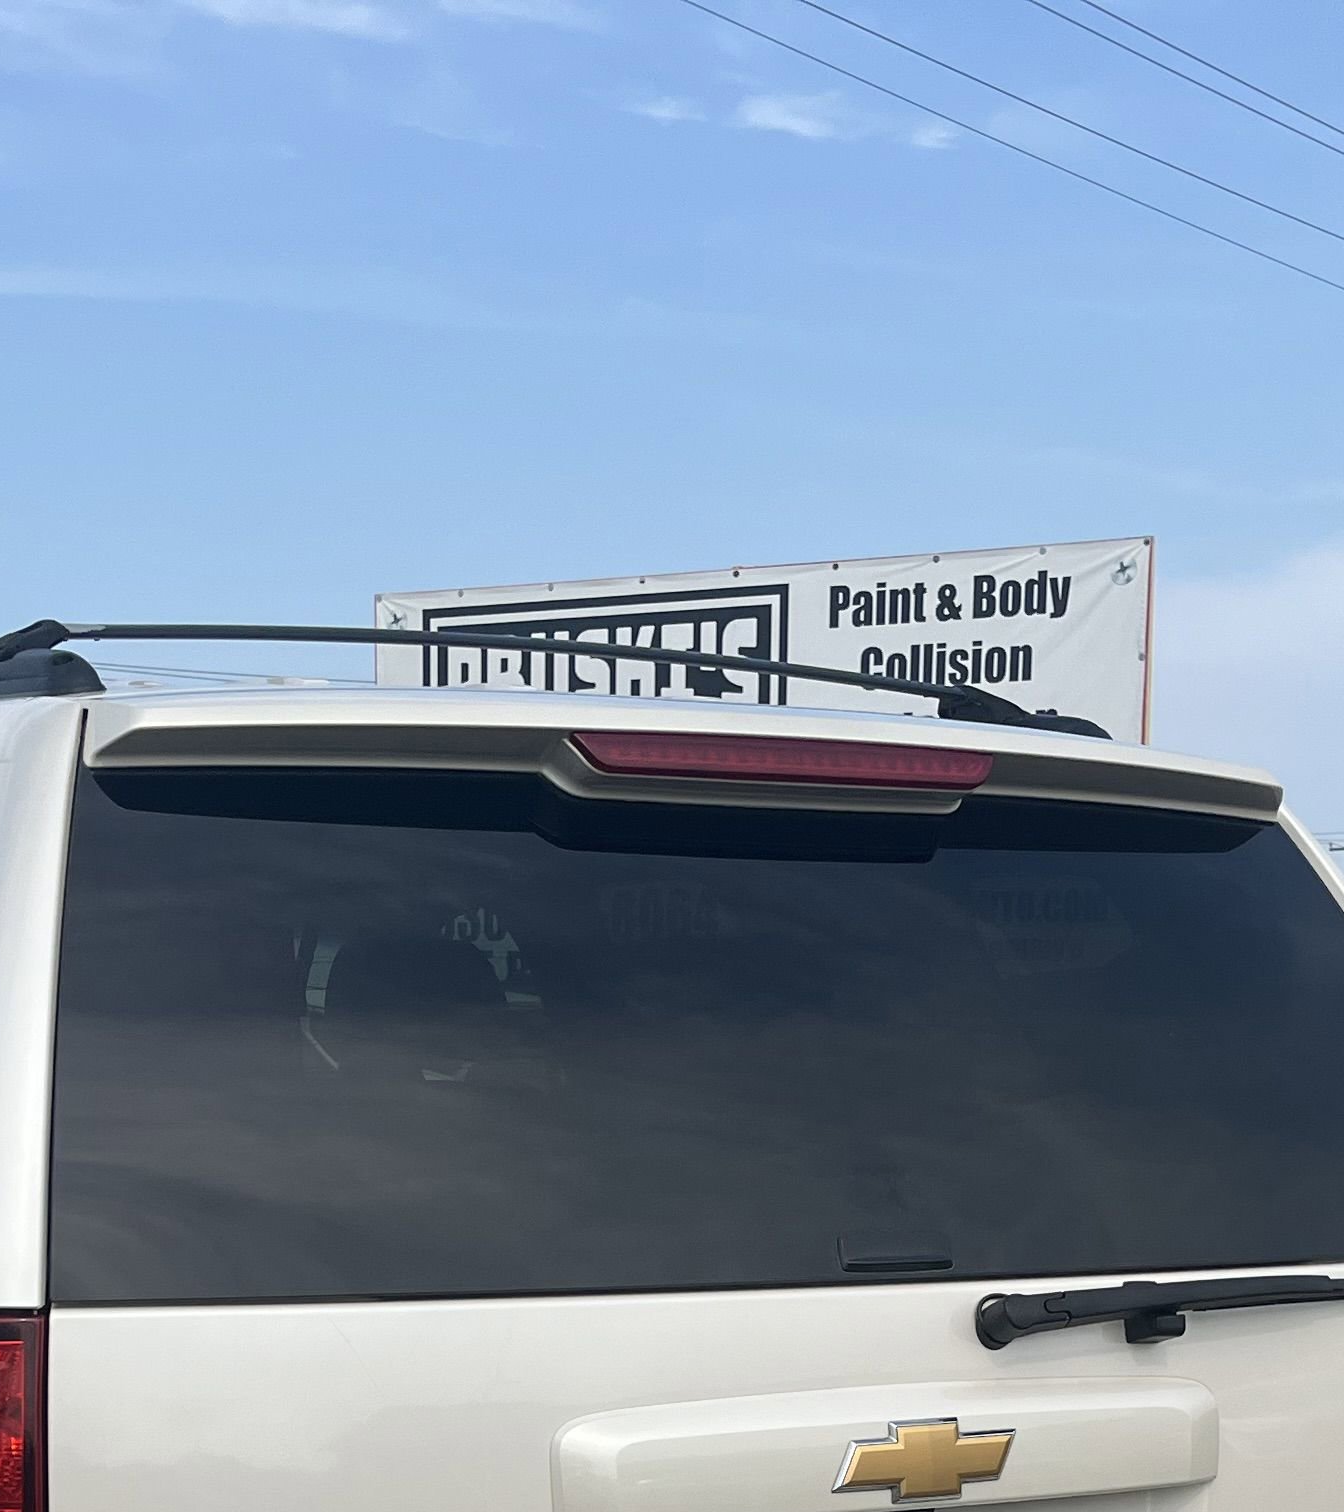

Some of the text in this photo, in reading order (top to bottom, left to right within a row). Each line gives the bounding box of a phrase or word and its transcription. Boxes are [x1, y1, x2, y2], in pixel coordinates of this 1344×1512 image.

[828, 569, 1072, 629] Paint & Body
[859, 640, 1034, 690] Collision
